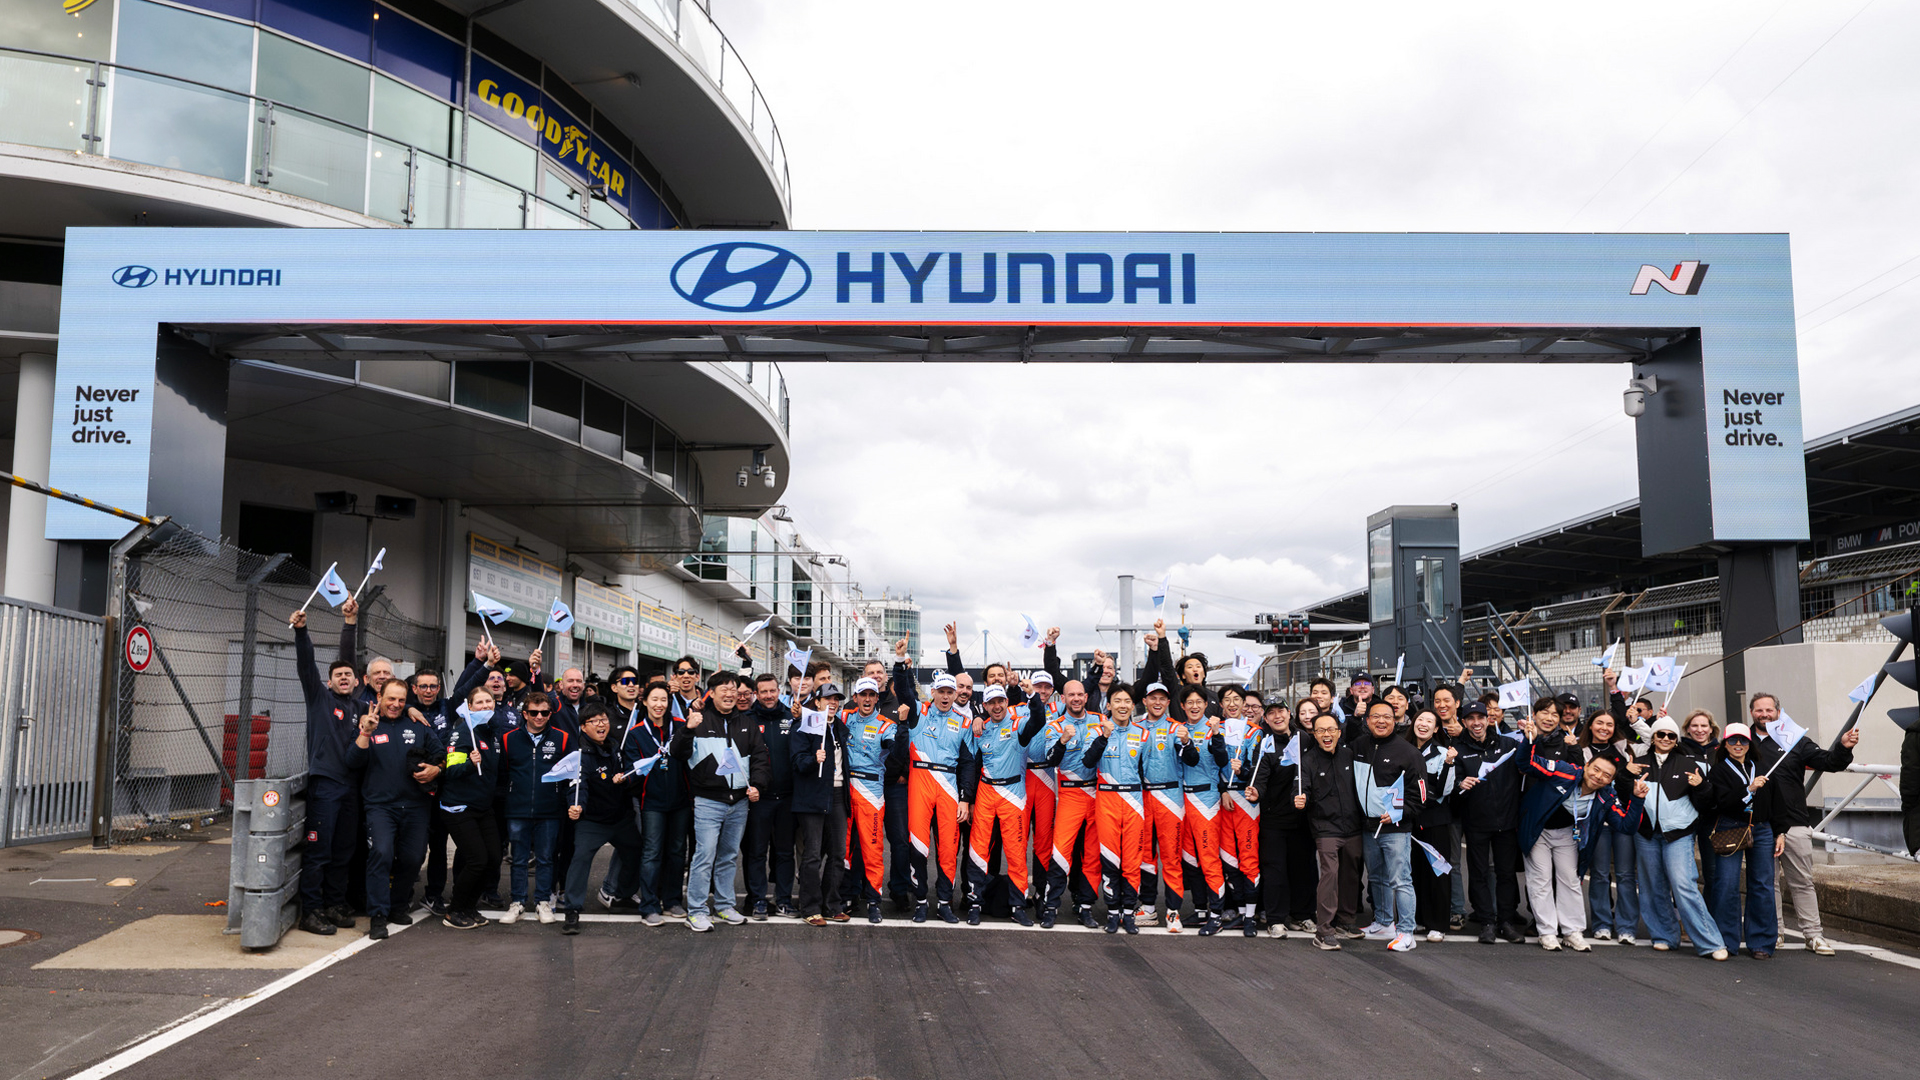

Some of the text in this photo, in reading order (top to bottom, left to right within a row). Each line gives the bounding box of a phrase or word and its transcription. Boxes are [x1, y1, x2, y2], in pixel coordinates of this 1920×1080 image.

[477, 79, 625, 197] GOODYEAR
[165, 268, 282, 286] HYUNDAI
[836, 251, 1197, 305] HYUNDAI
[75, 385, 140, 402] Never
[1723, 389, 1785, 406] Never
[72, 404, 114, 426] just
[1724, 407, 1763, 429] just
[71, 425, 131, 445] drive.
[1725, 428, 1784, 447] drive.
[1837, 532, 1862, 550] BMW
